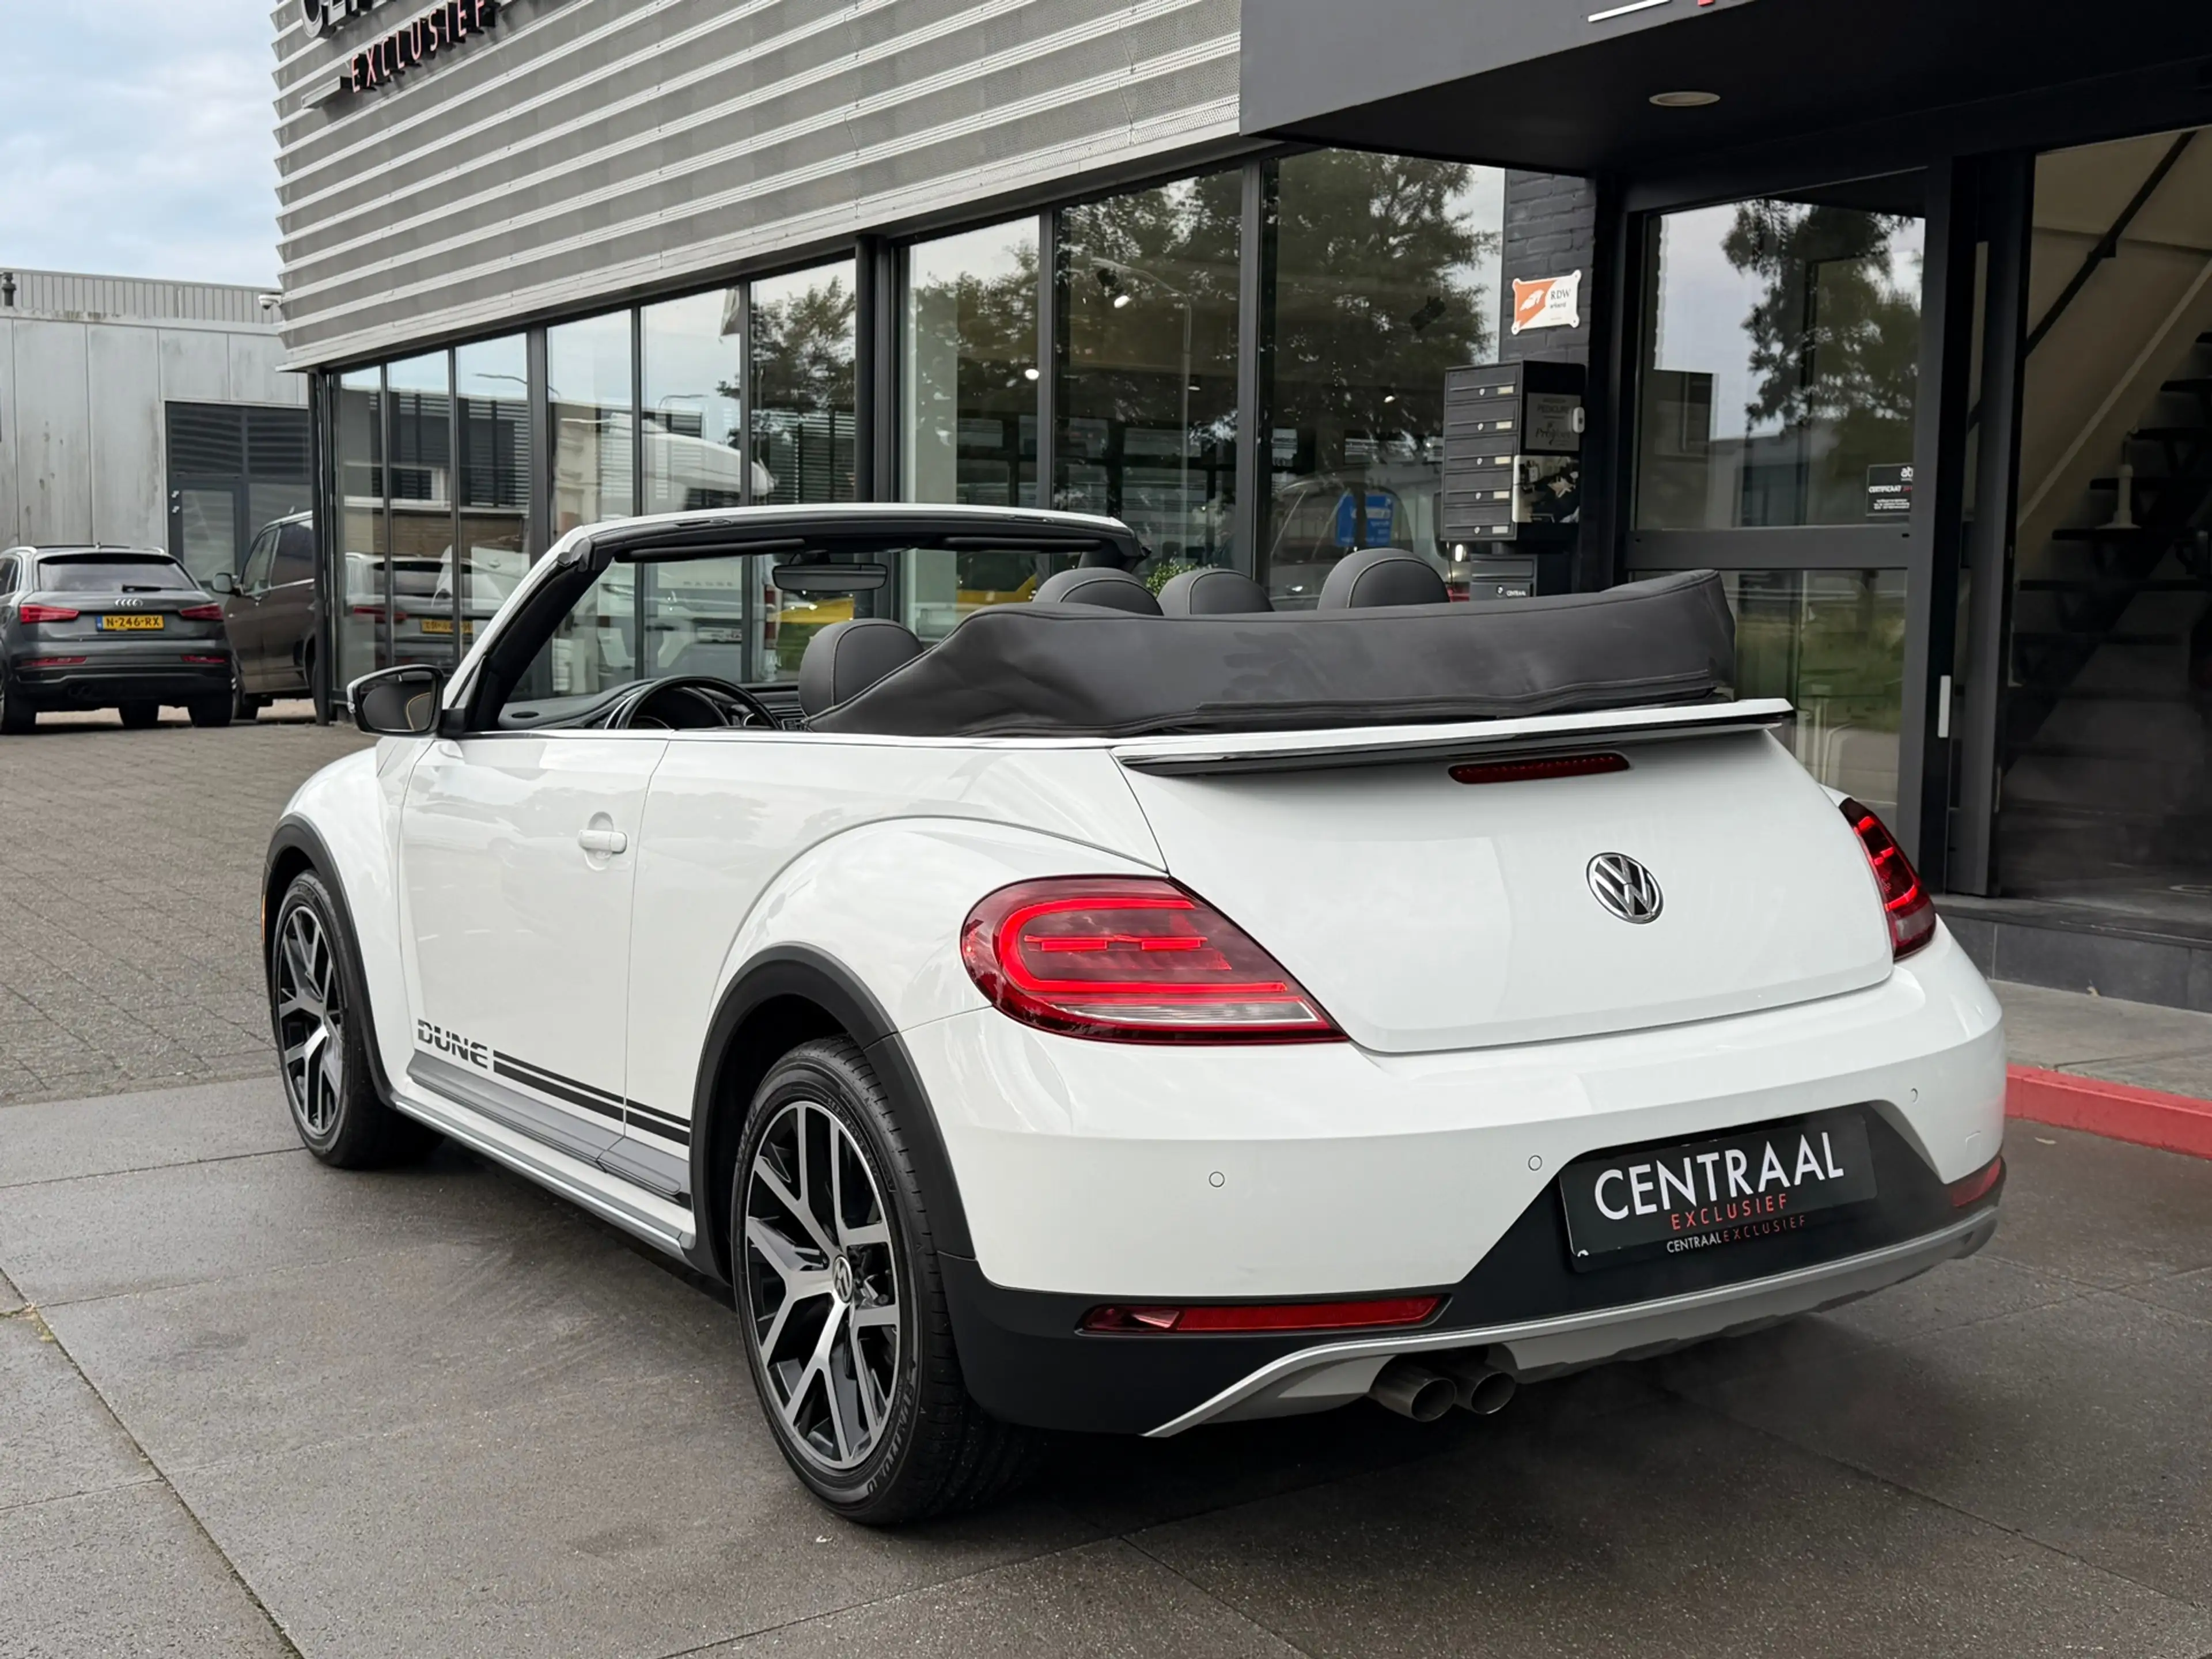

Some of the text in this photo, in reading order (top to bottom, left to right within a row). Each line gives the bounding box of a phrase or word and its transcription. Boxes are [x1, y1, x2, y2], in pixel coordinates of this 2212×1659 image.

[351, 0, 485, 93] EXCLUSIEF
[1550, 288, 1571, 300] RDW
[418, 1018, 488, 1070] DUNE
[1594, 1131, 1844, 1220] CENTRAAL
[1671, 1193, 1787, 1230] EXCLUSIEF
